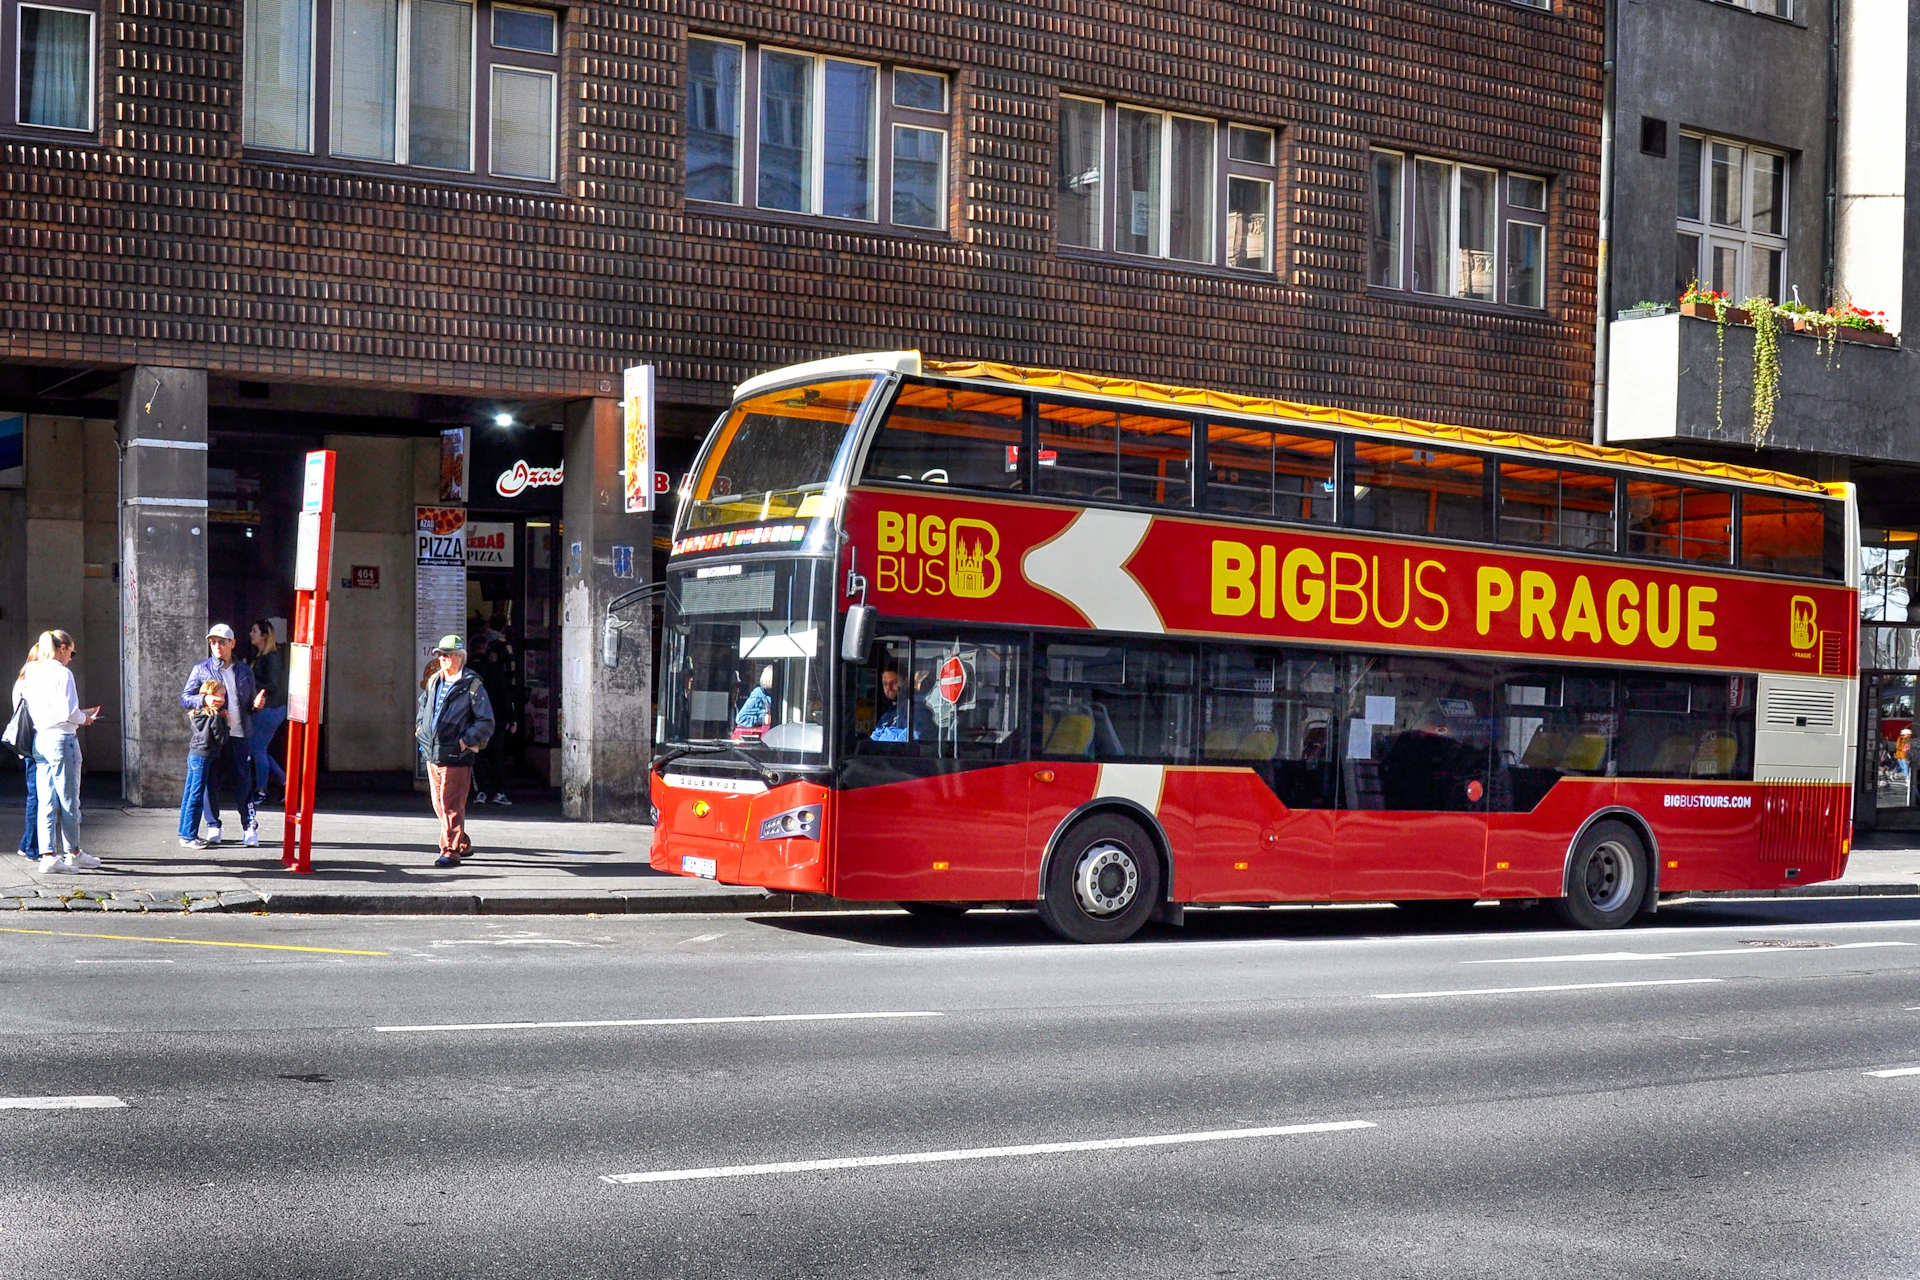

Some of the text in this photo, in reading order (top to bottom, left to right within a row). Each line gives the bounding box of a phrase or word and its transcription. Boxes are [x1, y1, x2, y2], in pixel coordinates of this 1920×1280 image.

[878, 510, 947, 556] BIG
[419, 537, 463, 558] PIZZA
[467, 551, 502, 562] PIZZA
[357, 568, 374, 579] 464
[877, 555, 947, 596] BUS
[1476, 566, 1718, 651] PRAGUE
[1664, 795, 1752, 808] BIGBUSTOURS.COM
